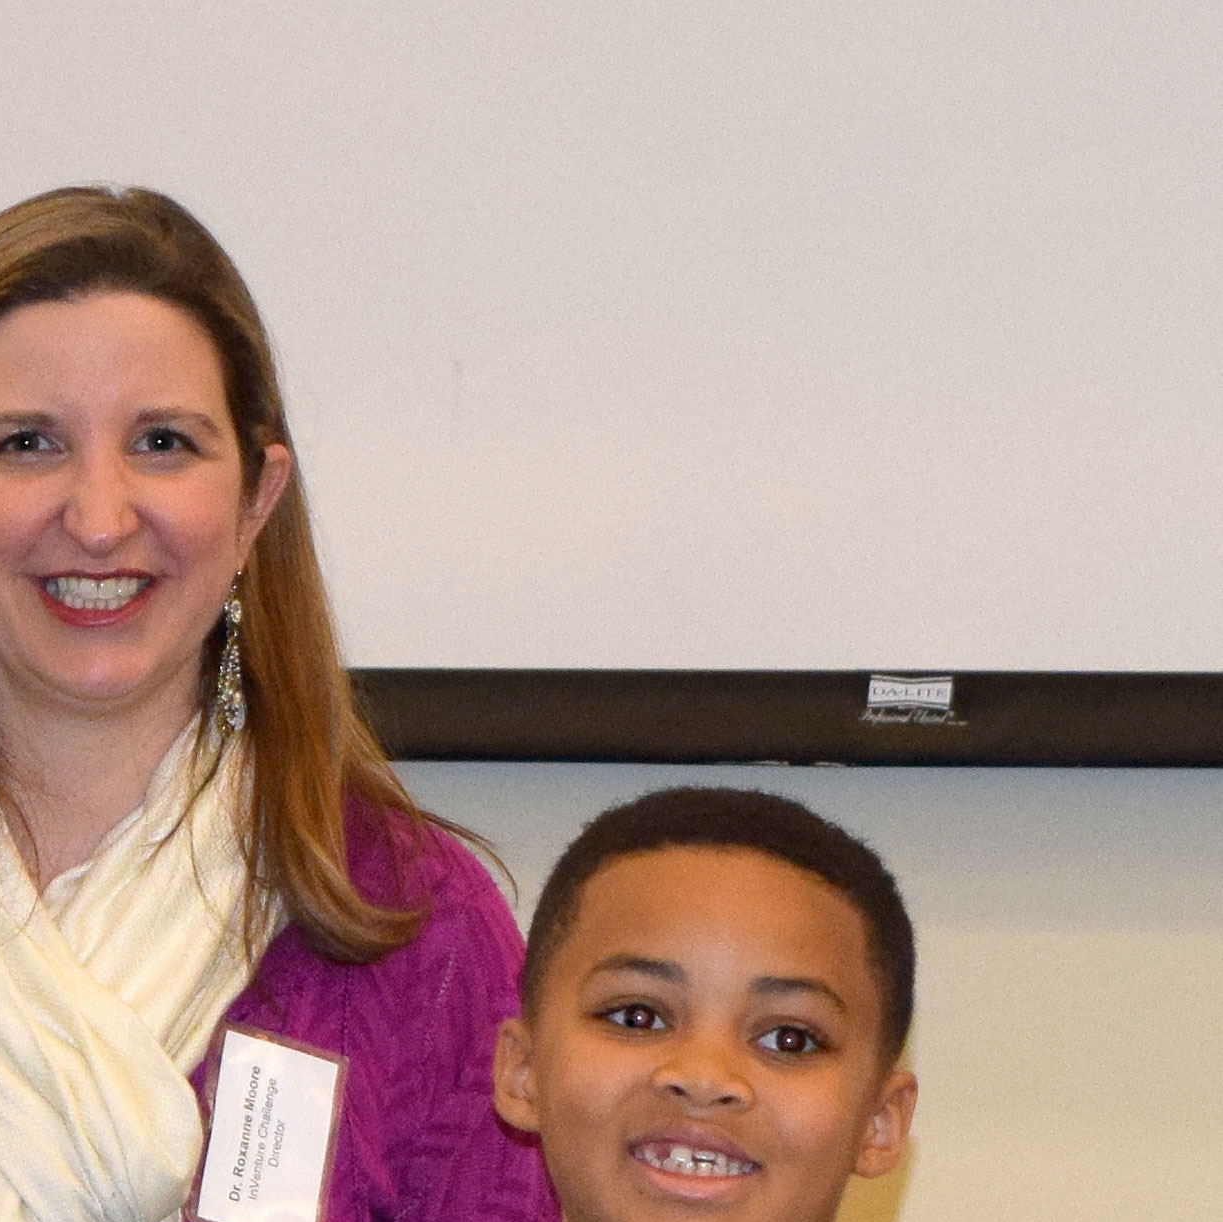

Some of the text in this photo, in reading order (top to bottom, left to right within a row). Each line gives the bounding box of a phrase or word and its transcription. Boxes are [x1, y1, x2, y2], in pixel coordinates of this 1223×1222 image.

[229, 1065, 261, 1202] Dr. Roxanne Moore
[248, 1078, 278, 1200] InVenture Challenge
[268, 1119, 286, 1168] Director
